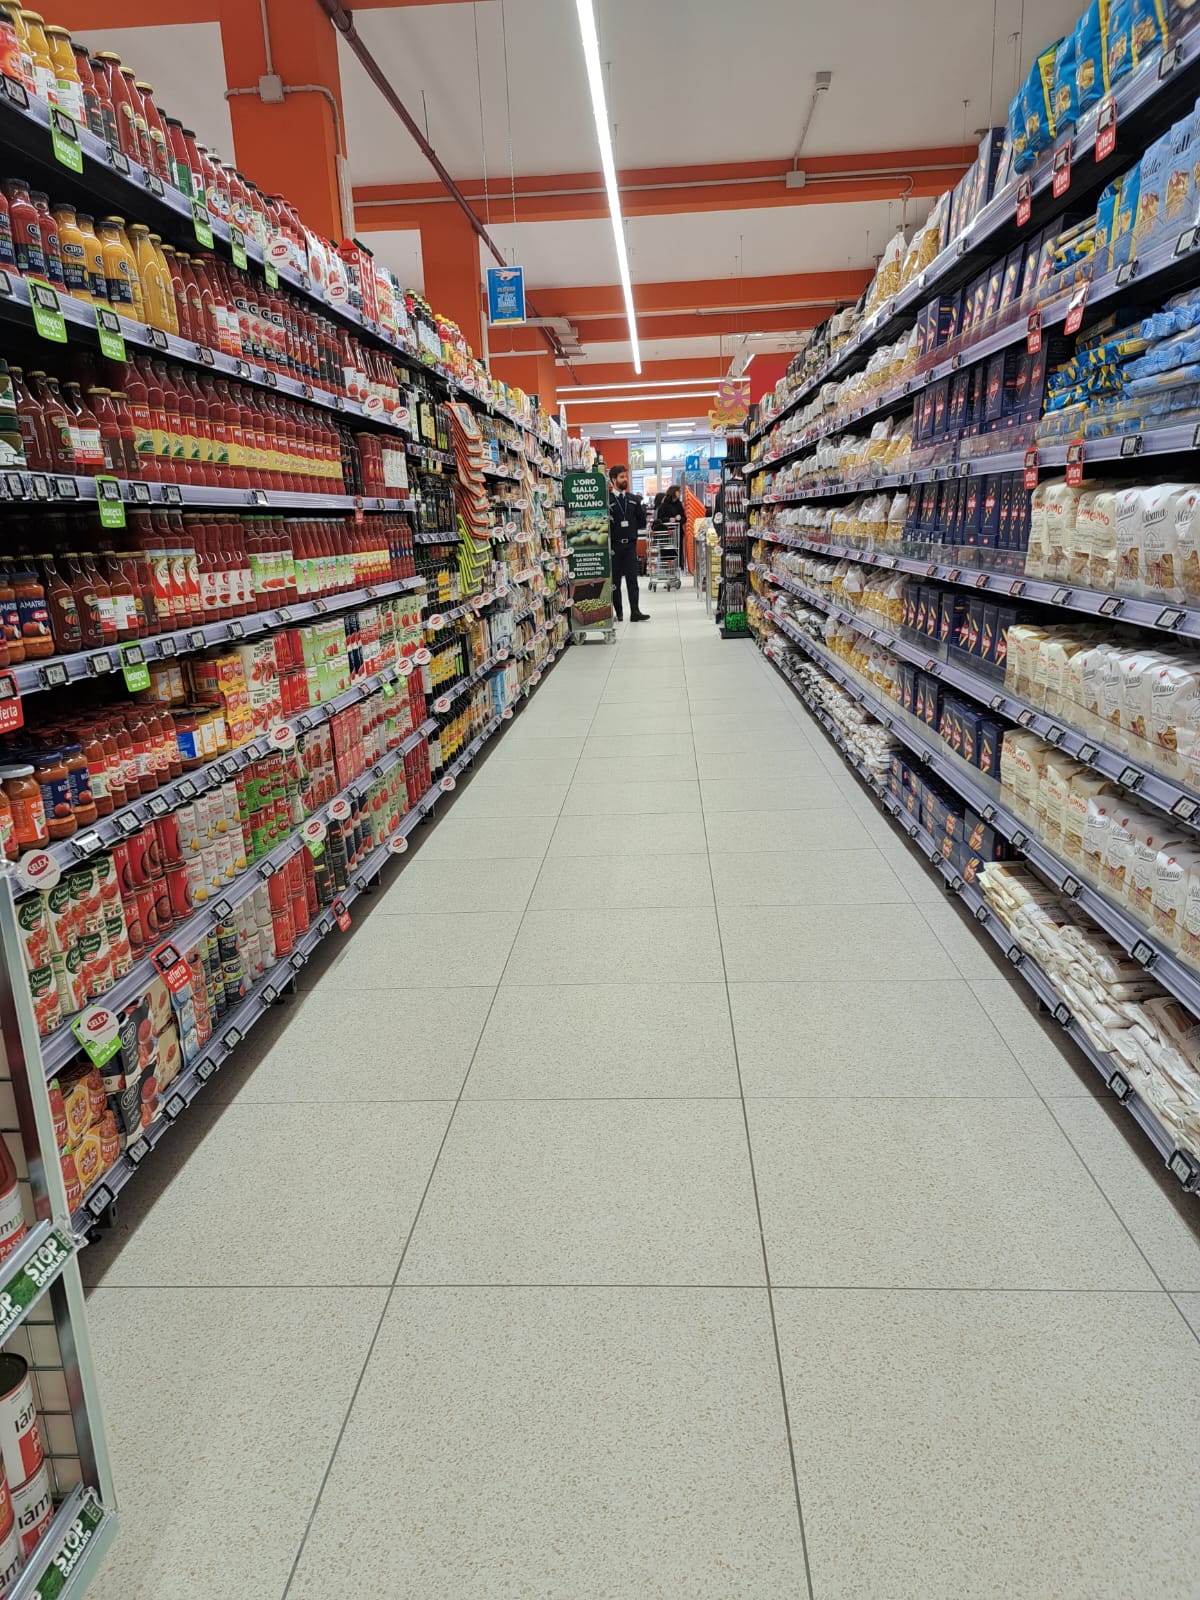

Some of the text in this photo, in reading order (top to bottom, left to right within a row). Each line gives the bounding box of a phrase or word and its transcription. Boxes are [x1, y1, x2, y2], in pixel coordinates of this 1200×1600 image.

[135, 410, 149, 418] MUT
[573, 478, 596, 486] L'ORO
[569, 500, 604, 508] ITALIANO
[576, 493, 595, 501] 100%
[29, 856, 49, 874] SELEX
[168, 965, 186, 984] offerta
[88, 1013, 109, 1029] SELEX
[24, 1237, 58, 1281] STOP
[35, 1250, 67, 1287] CAPORALATO
[52, 1519, 83, 1572] STOP
[62, 1530, 92, 1577] CAPORALATO
